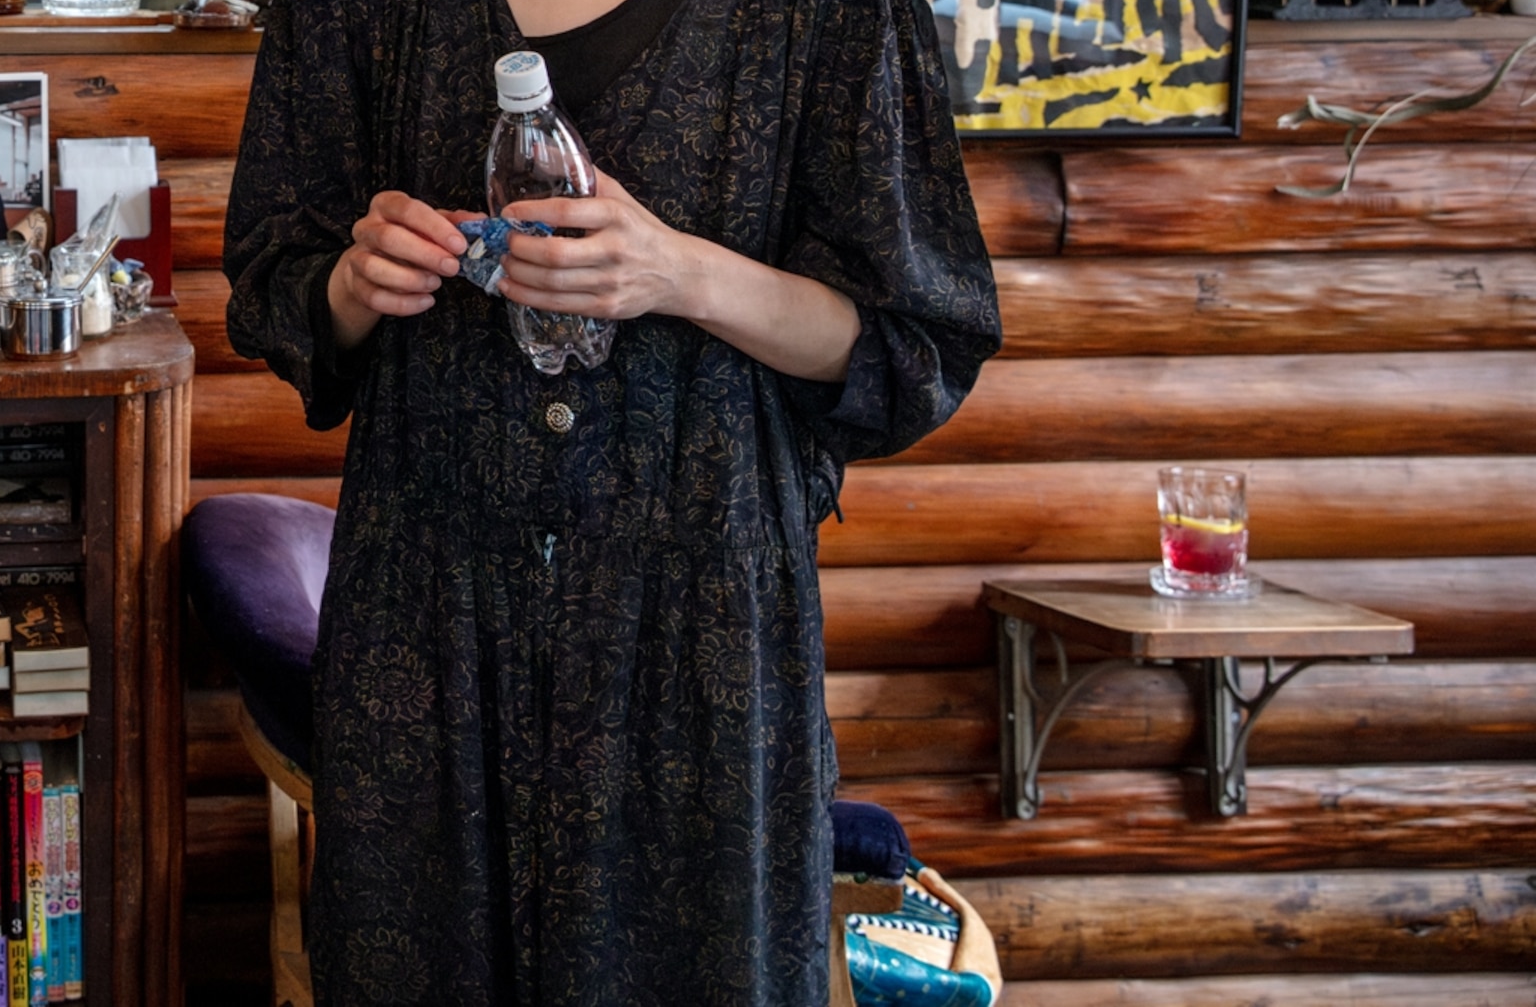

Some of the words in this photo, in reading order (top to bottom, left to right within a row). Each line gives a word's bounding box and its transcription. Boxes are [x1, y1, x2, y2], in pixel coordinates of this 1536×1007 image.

[18, 572, 75, 586] 410-7994
[11, 918, 23, 934] 3
[11, 944, 25, 1000] 山本直樹
